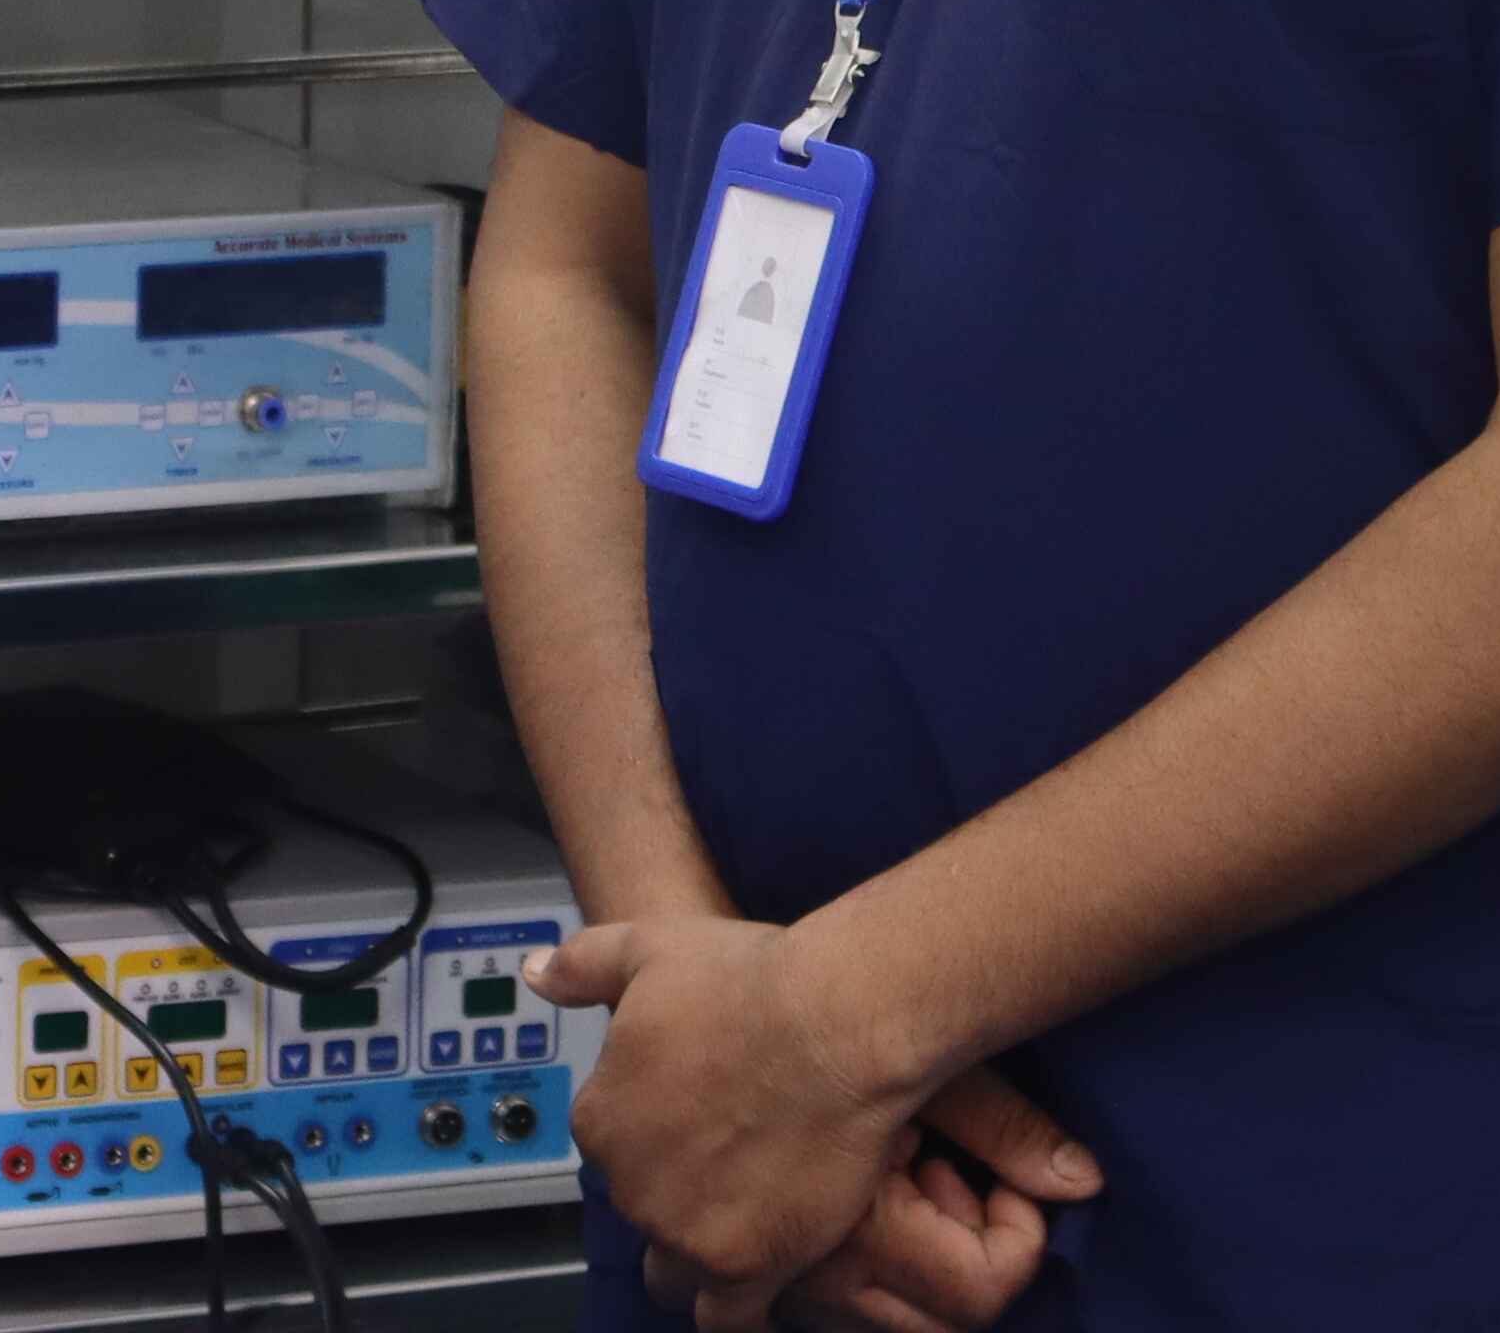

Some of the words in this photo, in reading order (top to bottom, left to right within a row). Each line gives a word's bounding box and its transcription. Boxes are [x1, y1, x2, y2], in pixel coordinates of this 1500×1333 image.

[214, 238, 280, 254] Accurate
[285, 234, 342, 249] Medical
[345, 231, 409, 247] Systems
